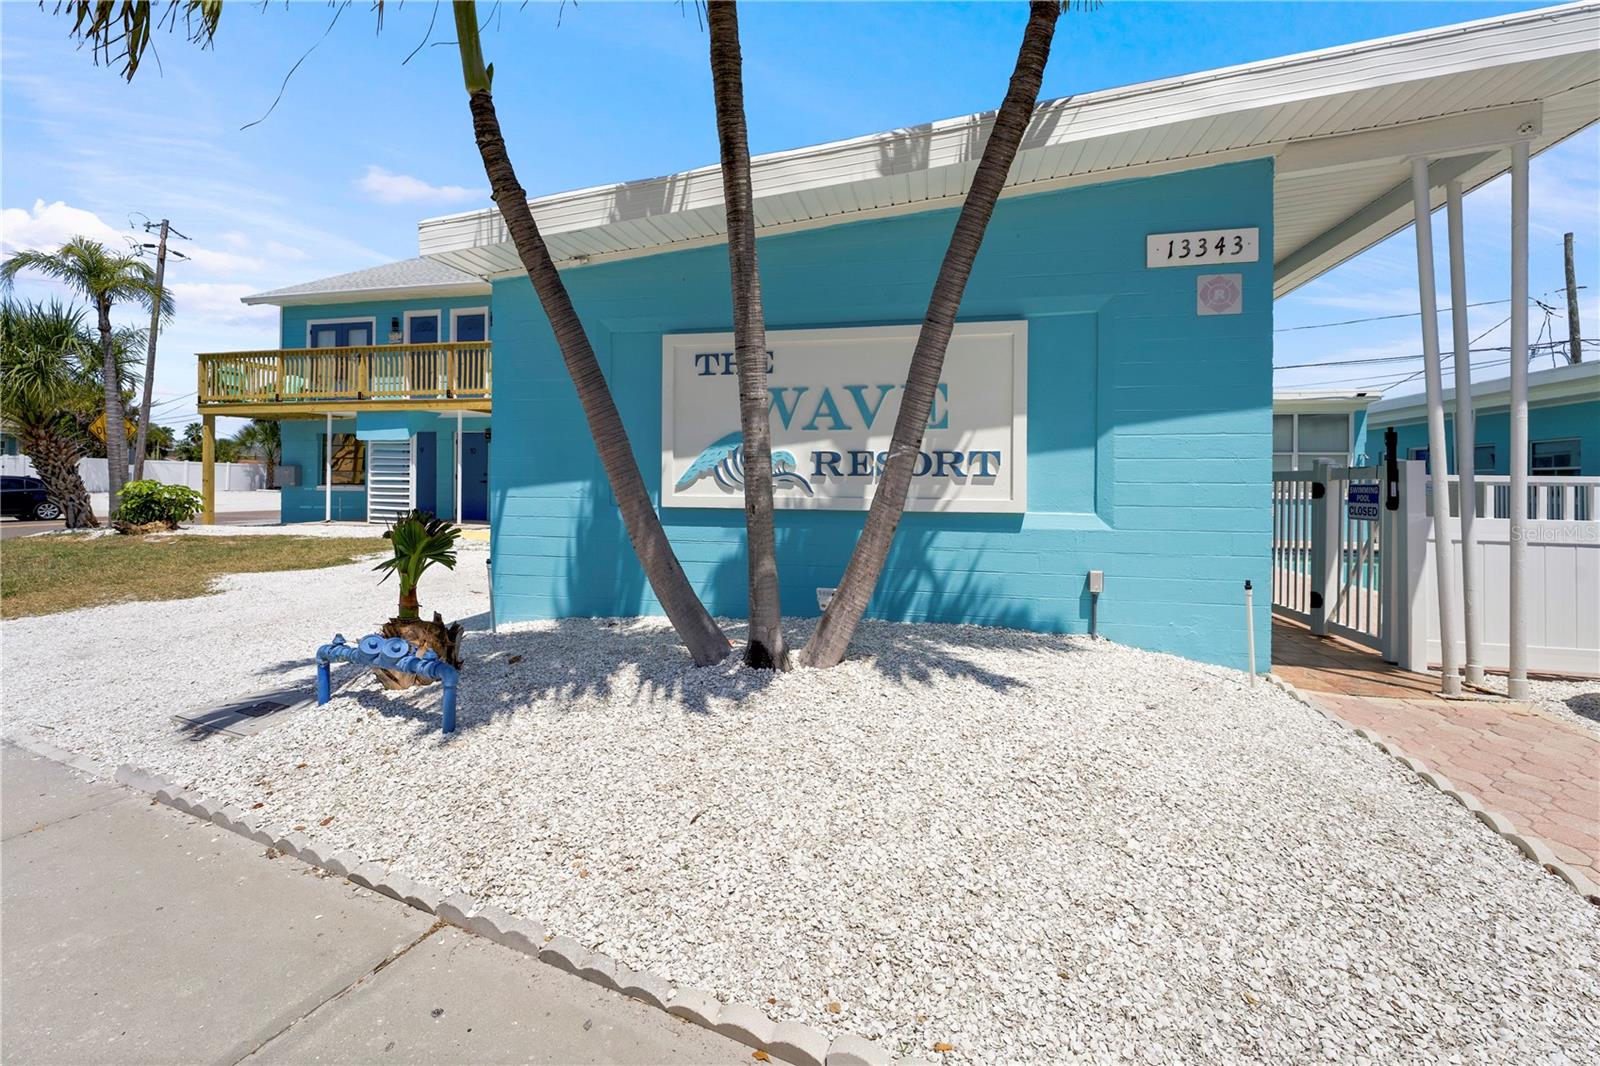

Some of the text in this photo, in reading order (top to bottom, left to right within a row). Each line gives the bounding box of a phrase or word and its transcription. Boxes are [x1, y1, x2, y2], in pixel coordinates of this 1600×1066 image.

[1167, 235, 1243, 259] 13343
[1356, 494, 1371, 502] POOL
[1349, 505, 1378, 517] CLOSED
